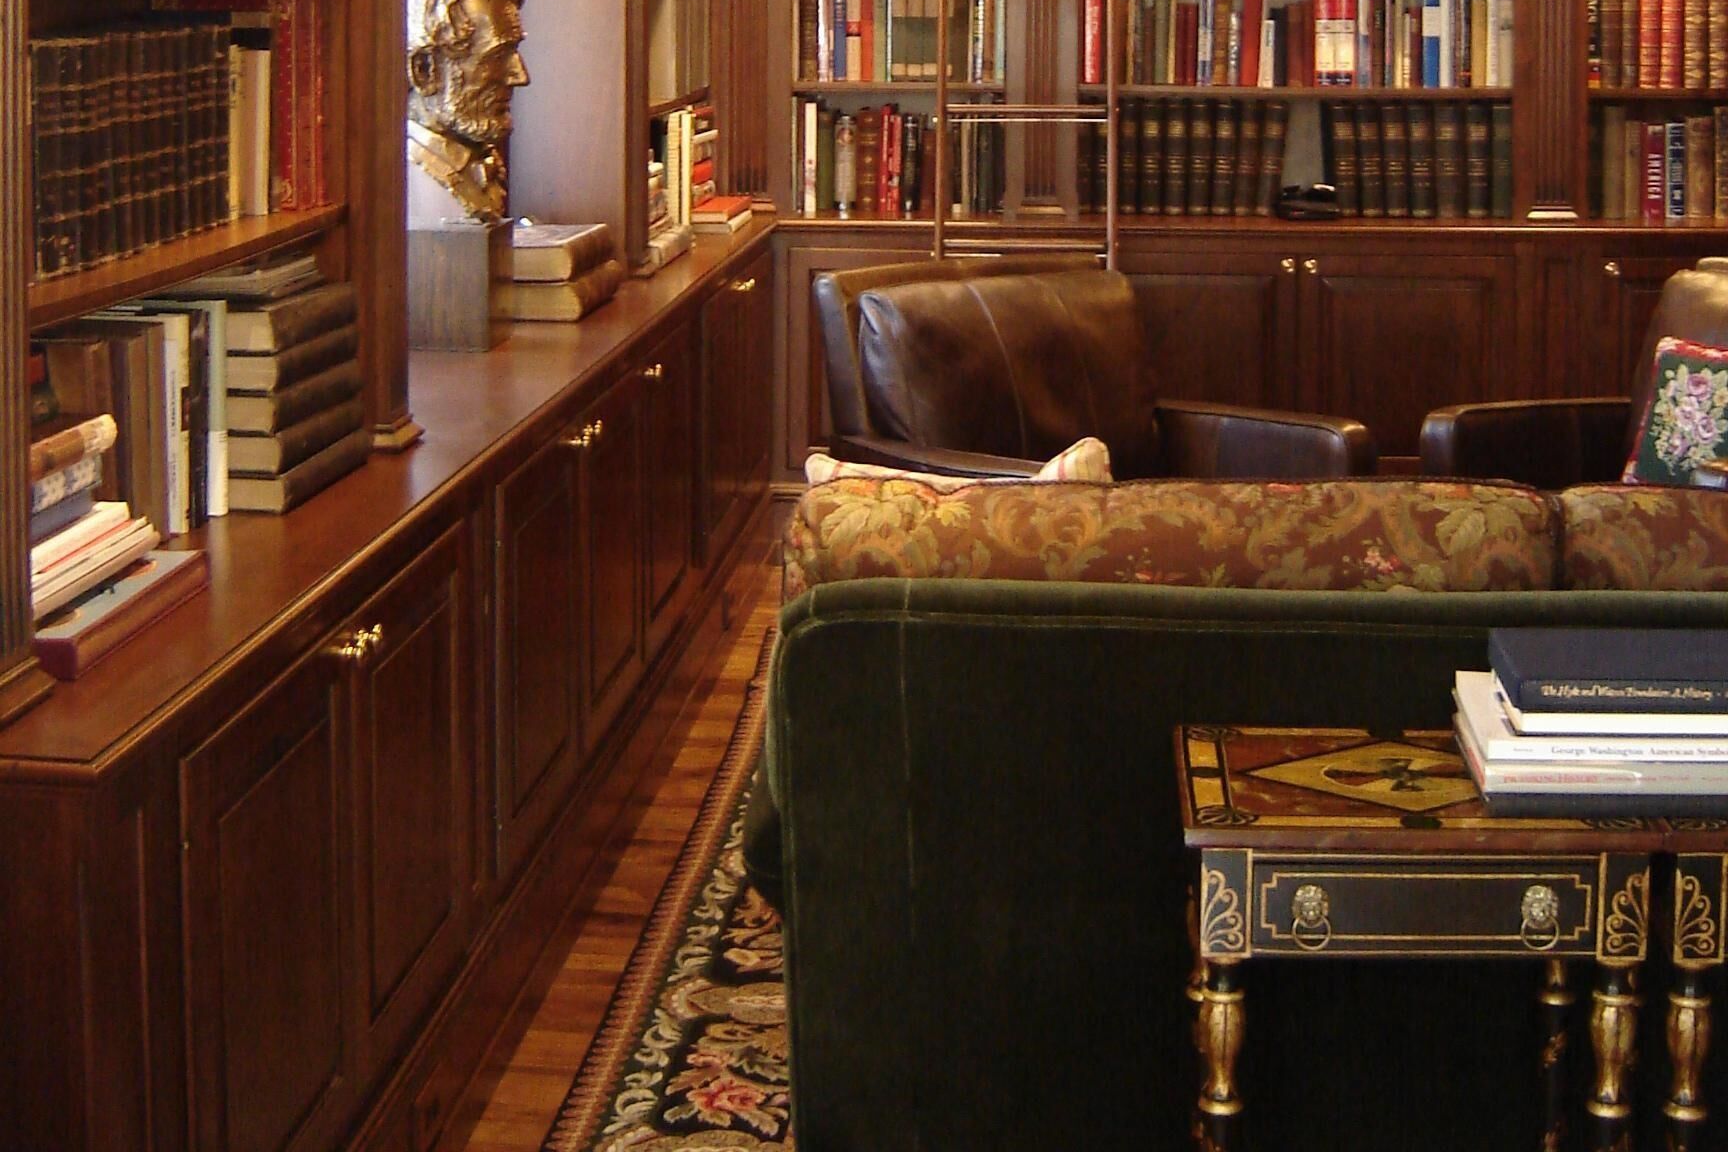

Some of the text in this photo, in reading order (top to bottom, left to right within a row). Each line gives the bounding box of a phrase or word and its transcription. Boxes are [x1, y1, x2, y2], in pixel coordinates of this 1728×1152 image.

[1648, 153, 1662, 199] AMERICA
[1551, 746, 1586, 757] George
[1589, 746, 1644, 757] Washington
[1650, 747, 1693, 756] American
